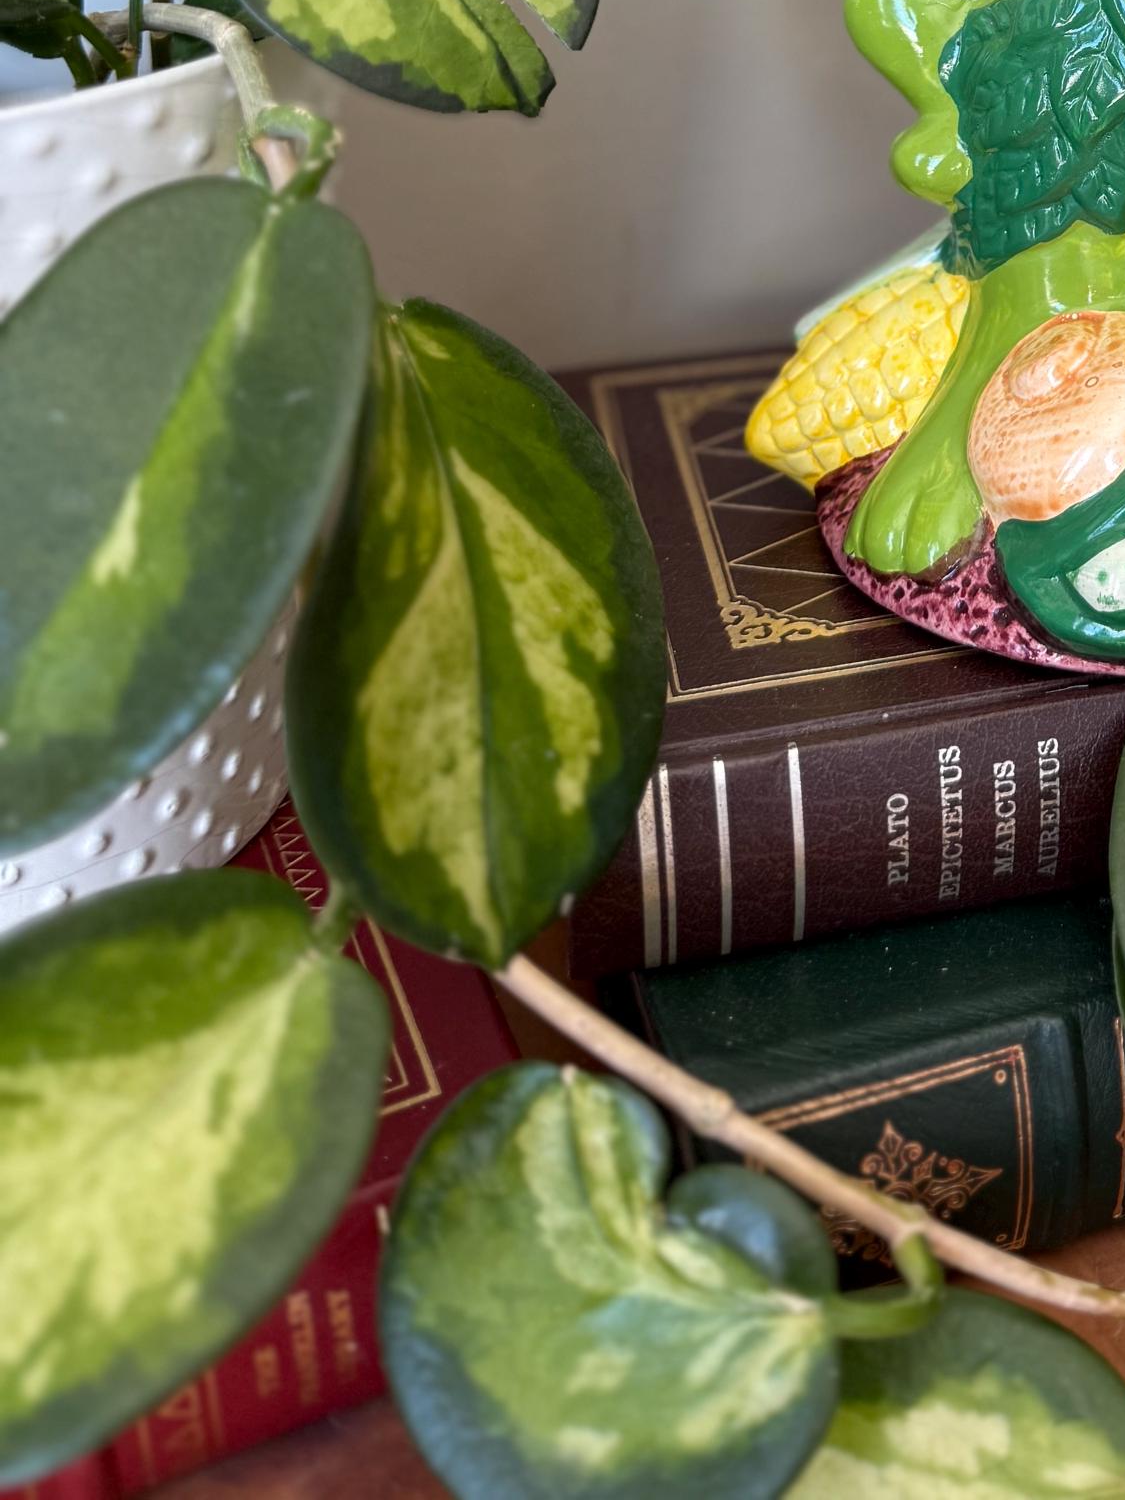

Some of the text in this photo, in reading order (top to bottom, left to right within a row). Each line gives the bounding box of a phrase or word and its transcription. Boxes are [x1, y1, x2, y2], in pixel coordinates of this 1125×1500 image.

[887, 793, 909, 886] PLATO
[938, 745, 962, 900] EPICTETUS
[993, 759, 1015, 876] MARCUS
[1037, 737, 1060, 877] AURELIUS
